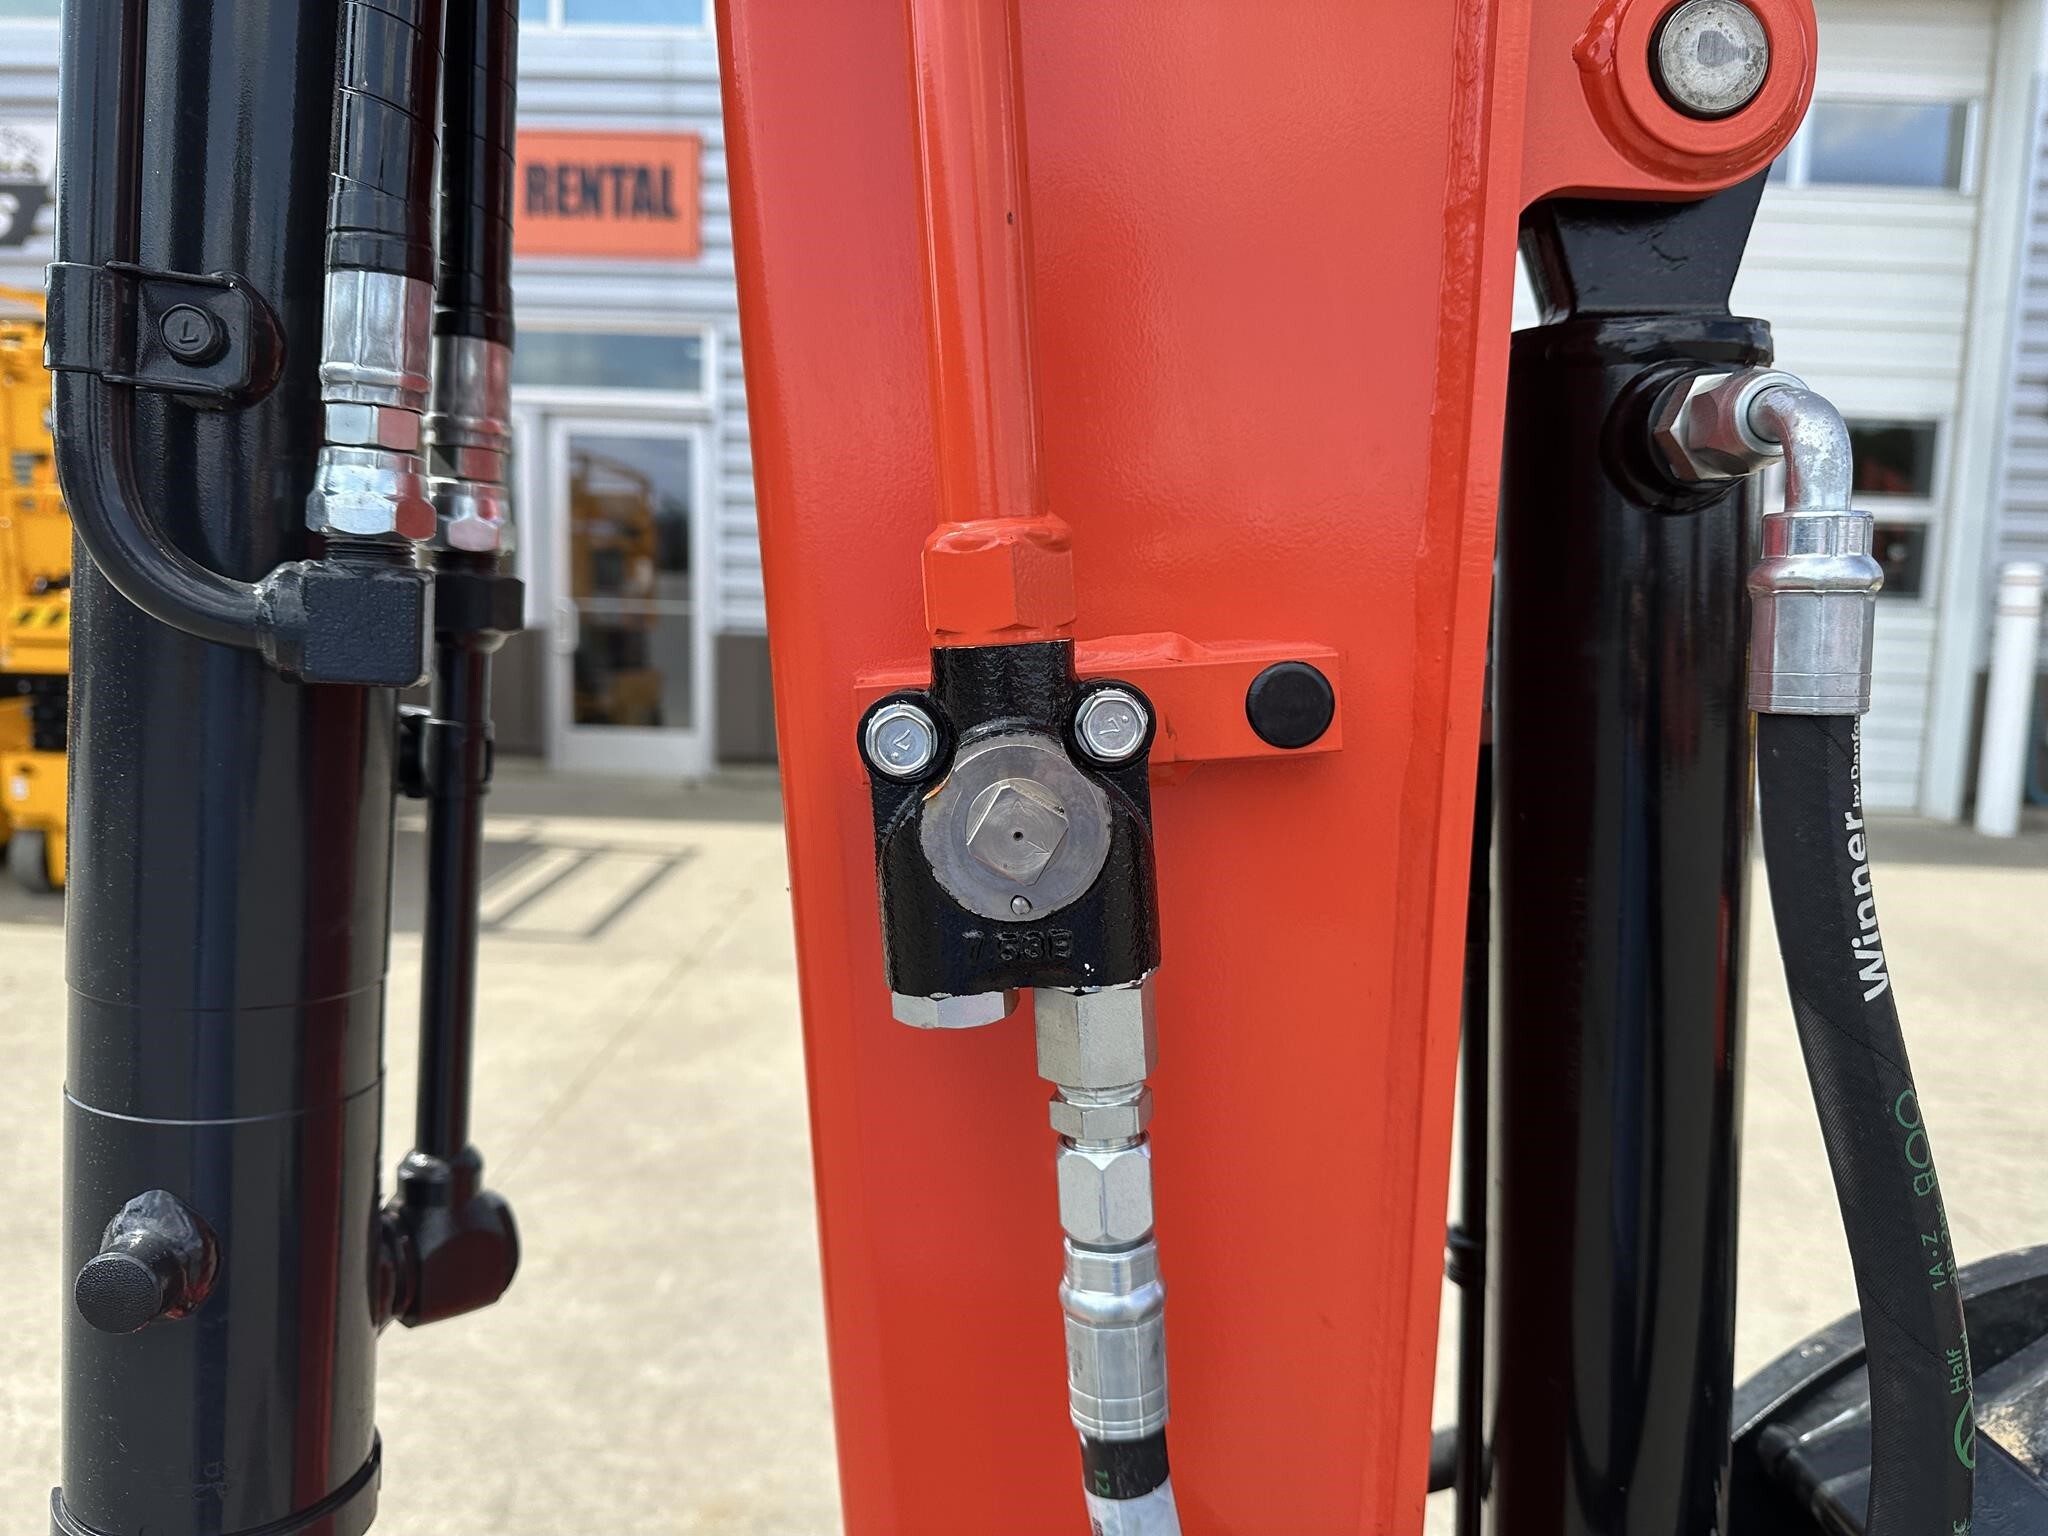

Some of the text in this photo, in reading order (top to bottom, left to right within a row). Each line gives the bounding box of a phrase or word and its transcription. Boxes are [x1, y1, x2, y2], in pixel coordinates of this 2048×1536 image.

[525, 162, 678, 220] RENTAL
[1844, 811, 1889, 1002] Winner
[1946, 1347, 1965, 1394] Half
